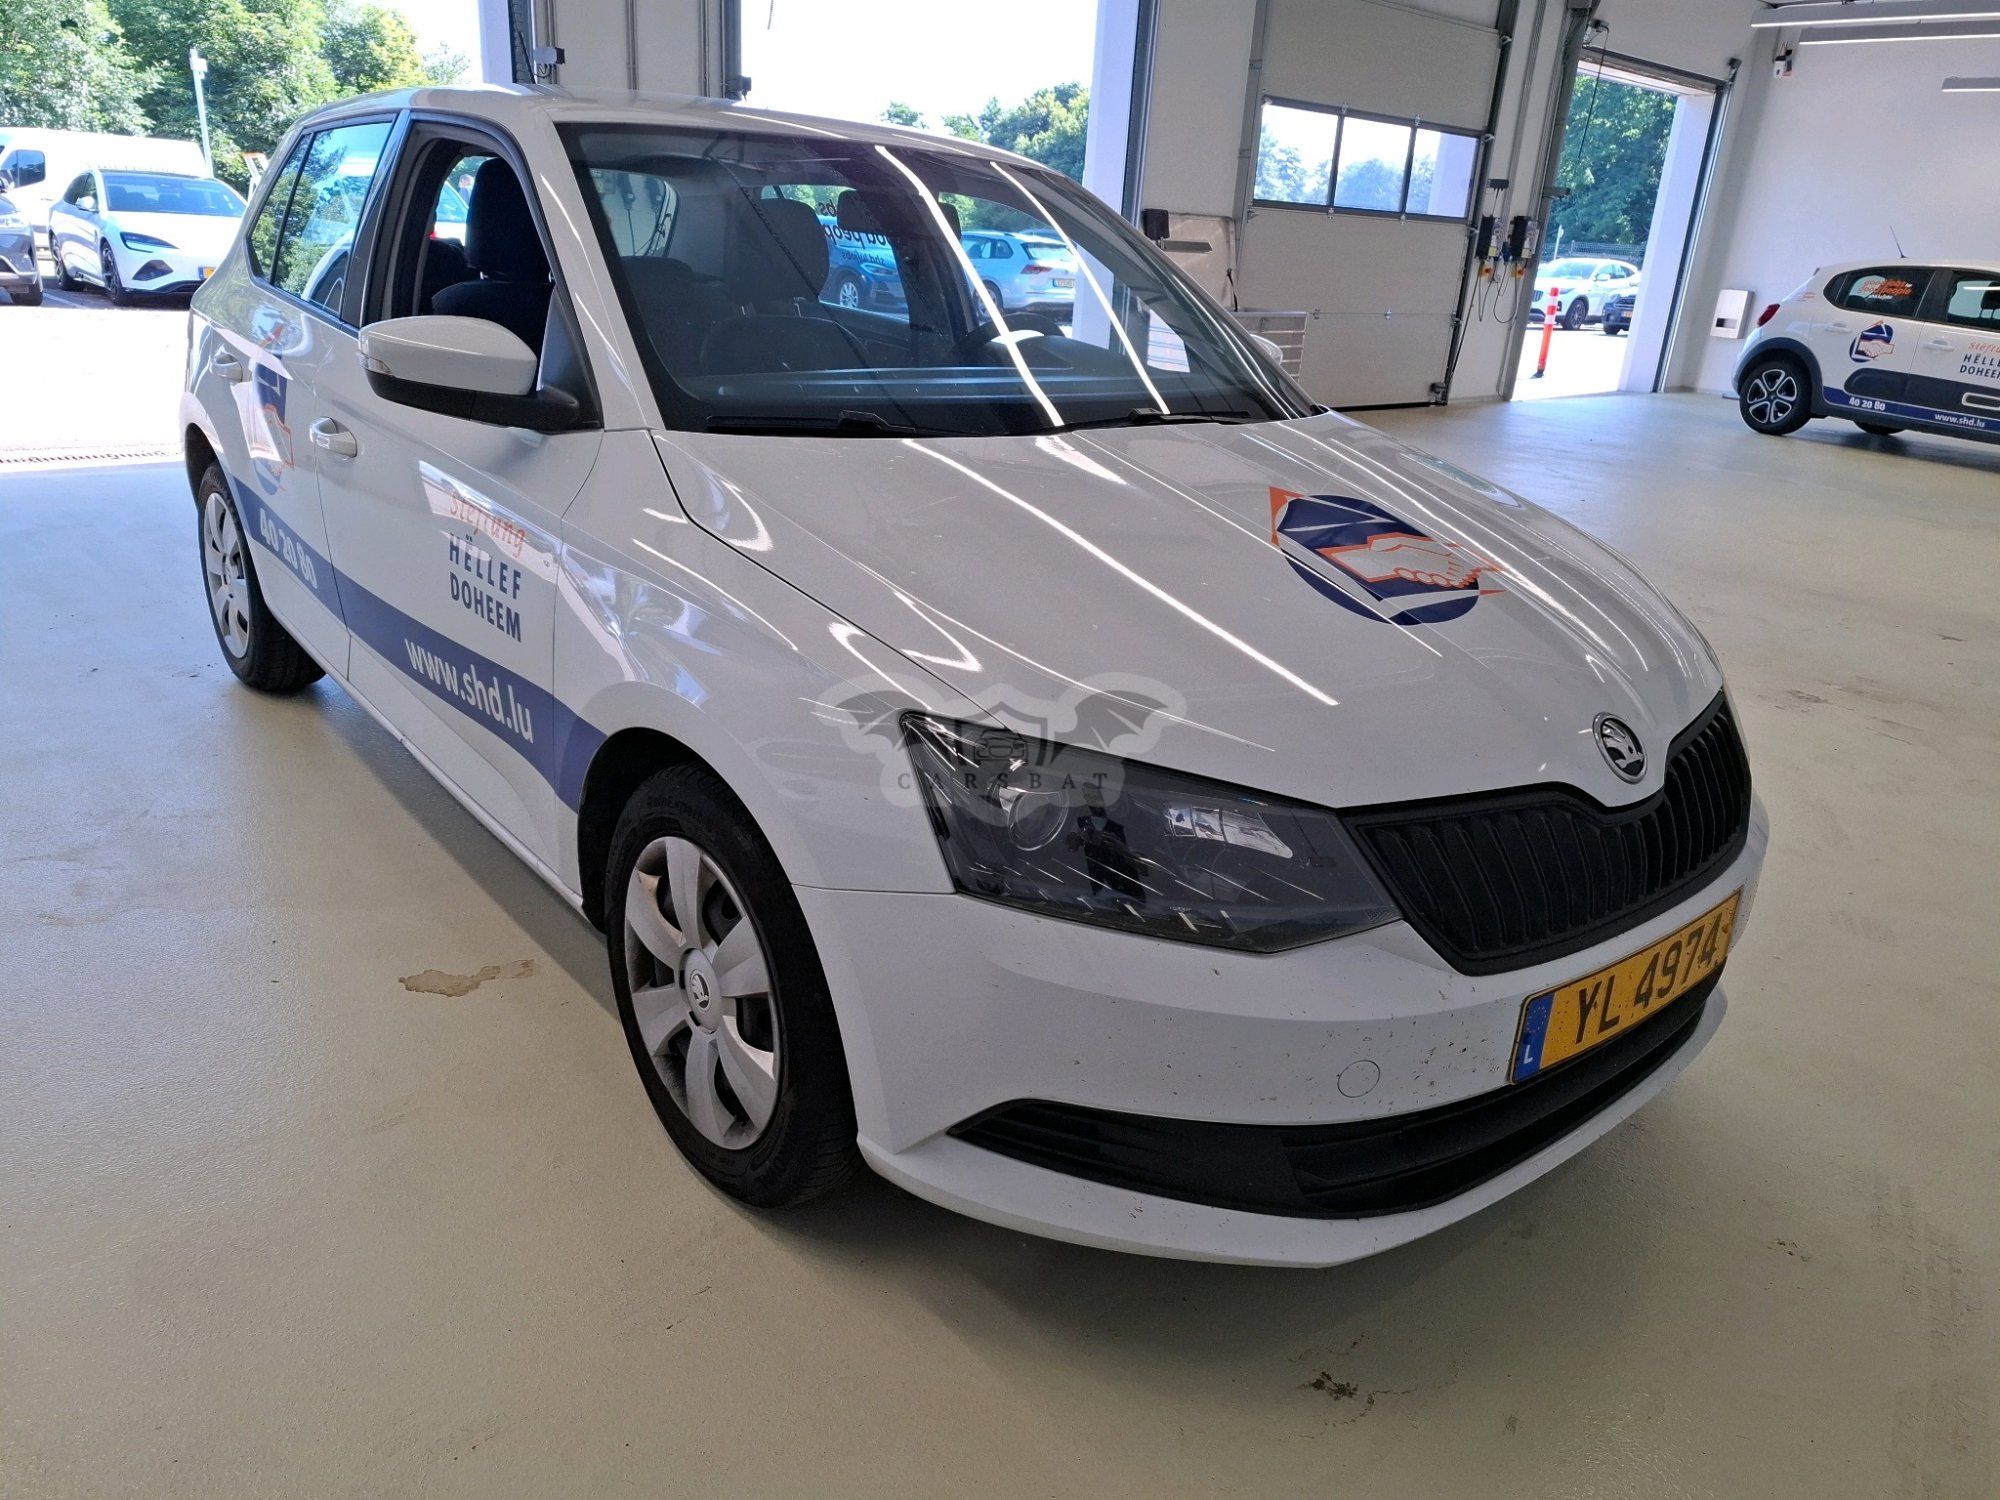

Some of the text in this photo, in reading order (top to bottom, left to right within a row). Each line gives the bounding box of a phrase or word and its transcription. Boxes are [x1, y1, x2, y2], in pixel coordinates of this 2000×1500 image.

[1959, 364, 2000, 379] DOHEE
[1963, 352, 2000, 367] HËLLE
[1849, 397, 1886, 411] 40 20 80
[1934, 413, 1986, 428] www.shd.lu
[260, 507, 318, 589] 40 20 80
[449, 533, 522, 600] HËLLEF
[449, 571, 522, 643] DOHEEM
[404, 638, 534, 744] www.shd.lu
[1575, 911, 1724, 1045] YL 4974
[1523, 1044, 1534, 1065] L
